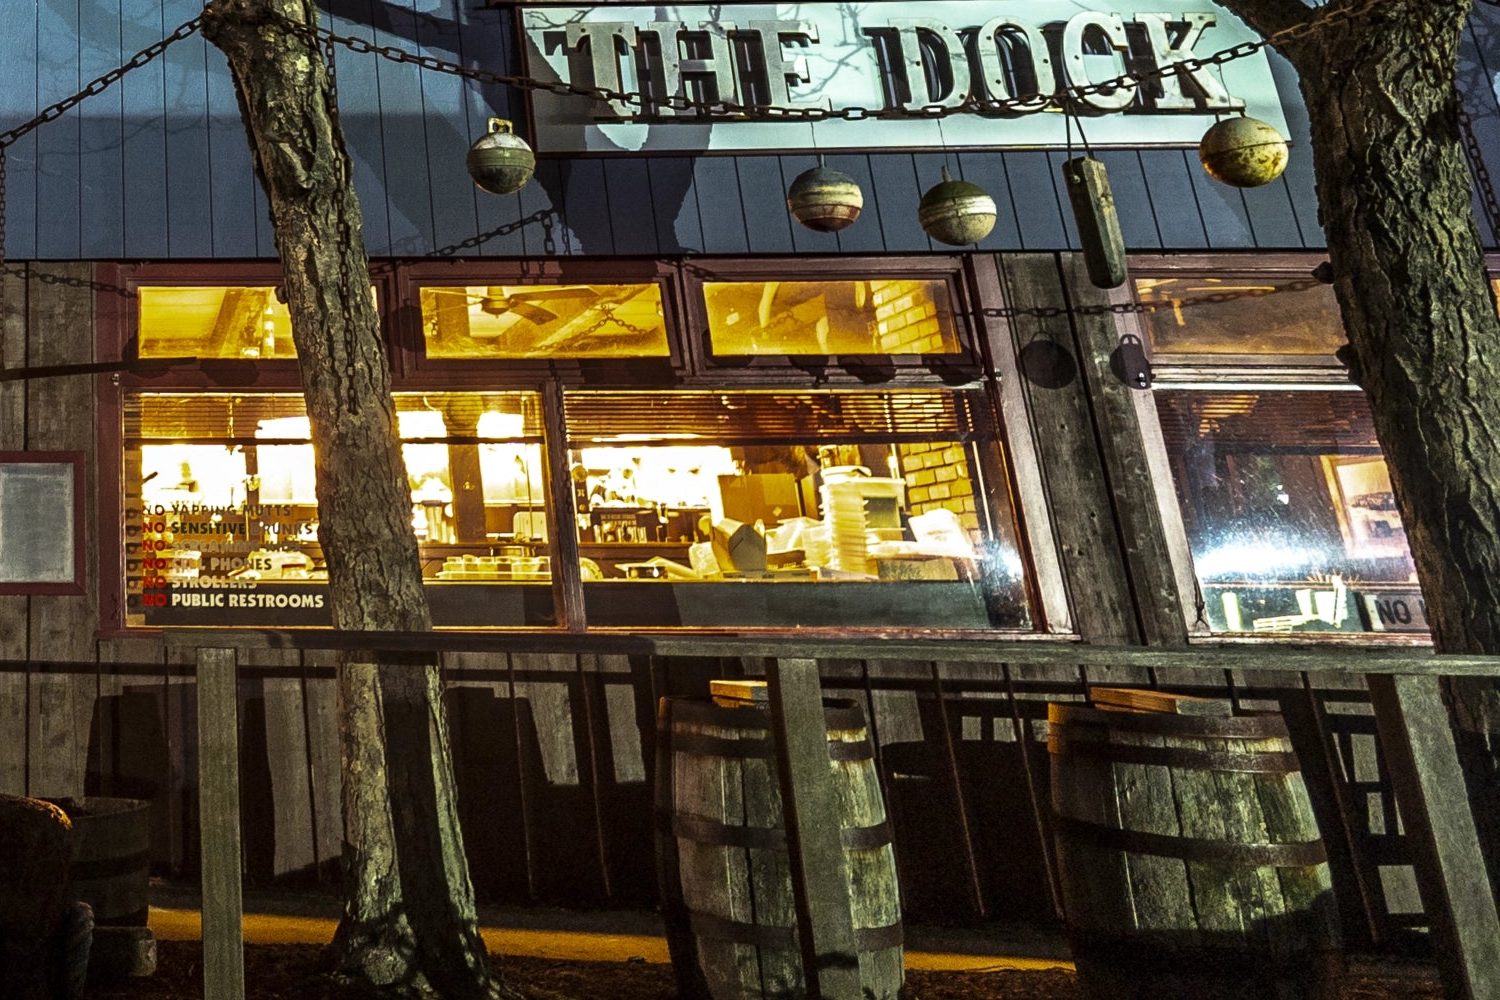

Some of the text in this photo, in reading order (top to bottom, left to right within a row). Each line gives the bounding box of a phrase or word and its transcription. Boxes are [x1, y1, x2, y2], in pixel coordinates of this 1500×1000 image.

[566, 11, 1246, 116] THE DOCK
[143, 504, 291, 517] NO YAPPING MUTTS
[143, 522, 313, 535] NO SENSITIVE DRUNKS
[143, 540, 166, 552] NO
[171, 540, 262, 553] SCREAMING
[143, 558, 167, 570] NO
[210, 557, 272, 571] PHONES
[143, 576, 257, 589] NO STROLLERS
[143, 593, 324, 608] NO PUBLIC RESTROOMS
[1374, 599, 1412, 625] NO
